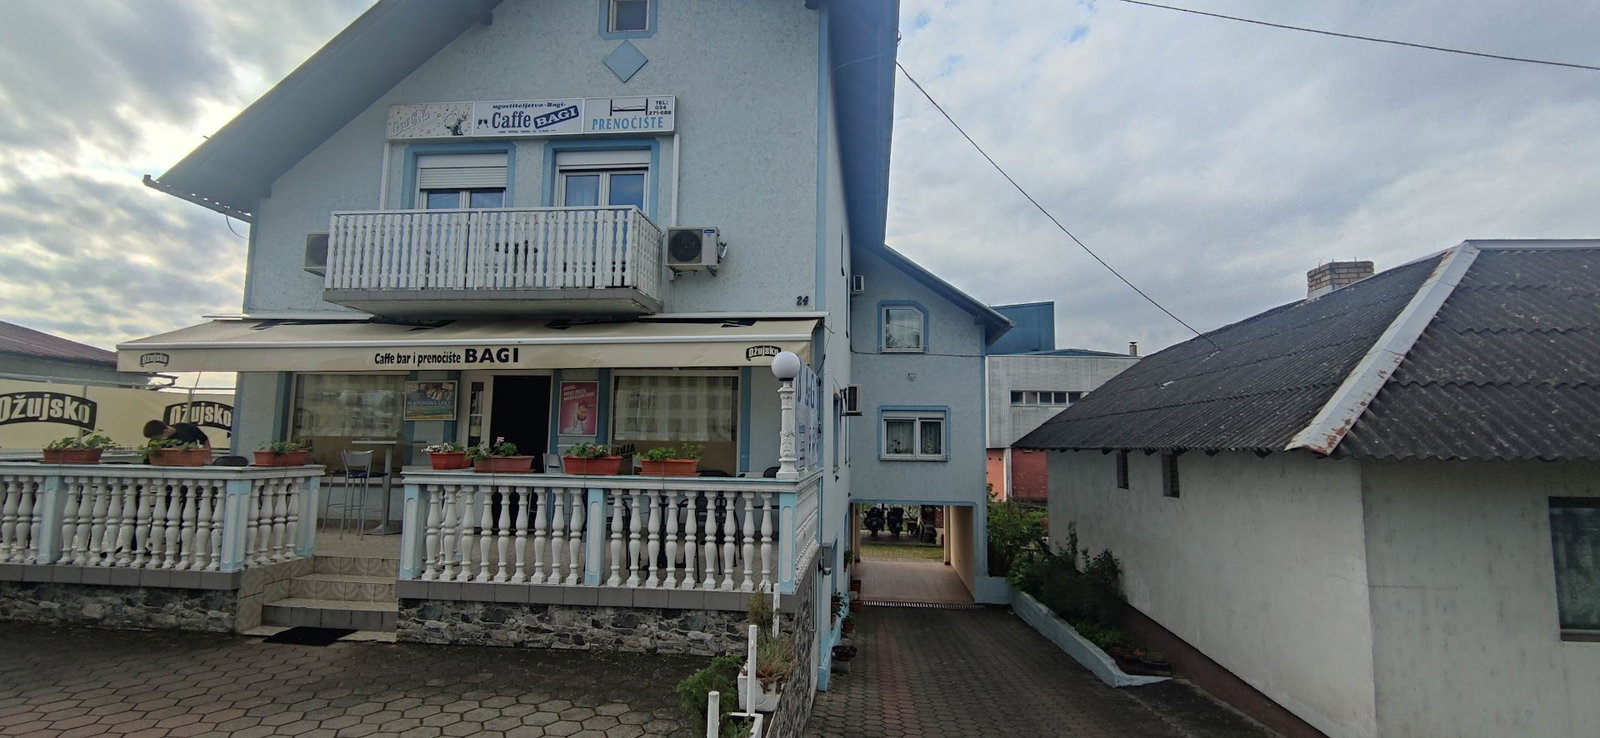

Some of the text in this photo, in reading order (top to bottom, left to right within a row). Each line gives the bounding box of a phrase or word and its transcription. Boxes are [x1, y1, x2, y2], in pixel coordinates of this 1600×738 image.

[492, 102, 544, 110] ugostiteljstvo
[491, 107, 577, 129] Caffe BAGI
[374, 353, 395, 365] Caffe
[396, 353, 411, 364] bar
[412, 352, 416, 364] i
[464, 347, 519, 363] BAGI
[748, 345, 779, 358] Ožujsko
[169, 402, 232, 427] Ožujsko
